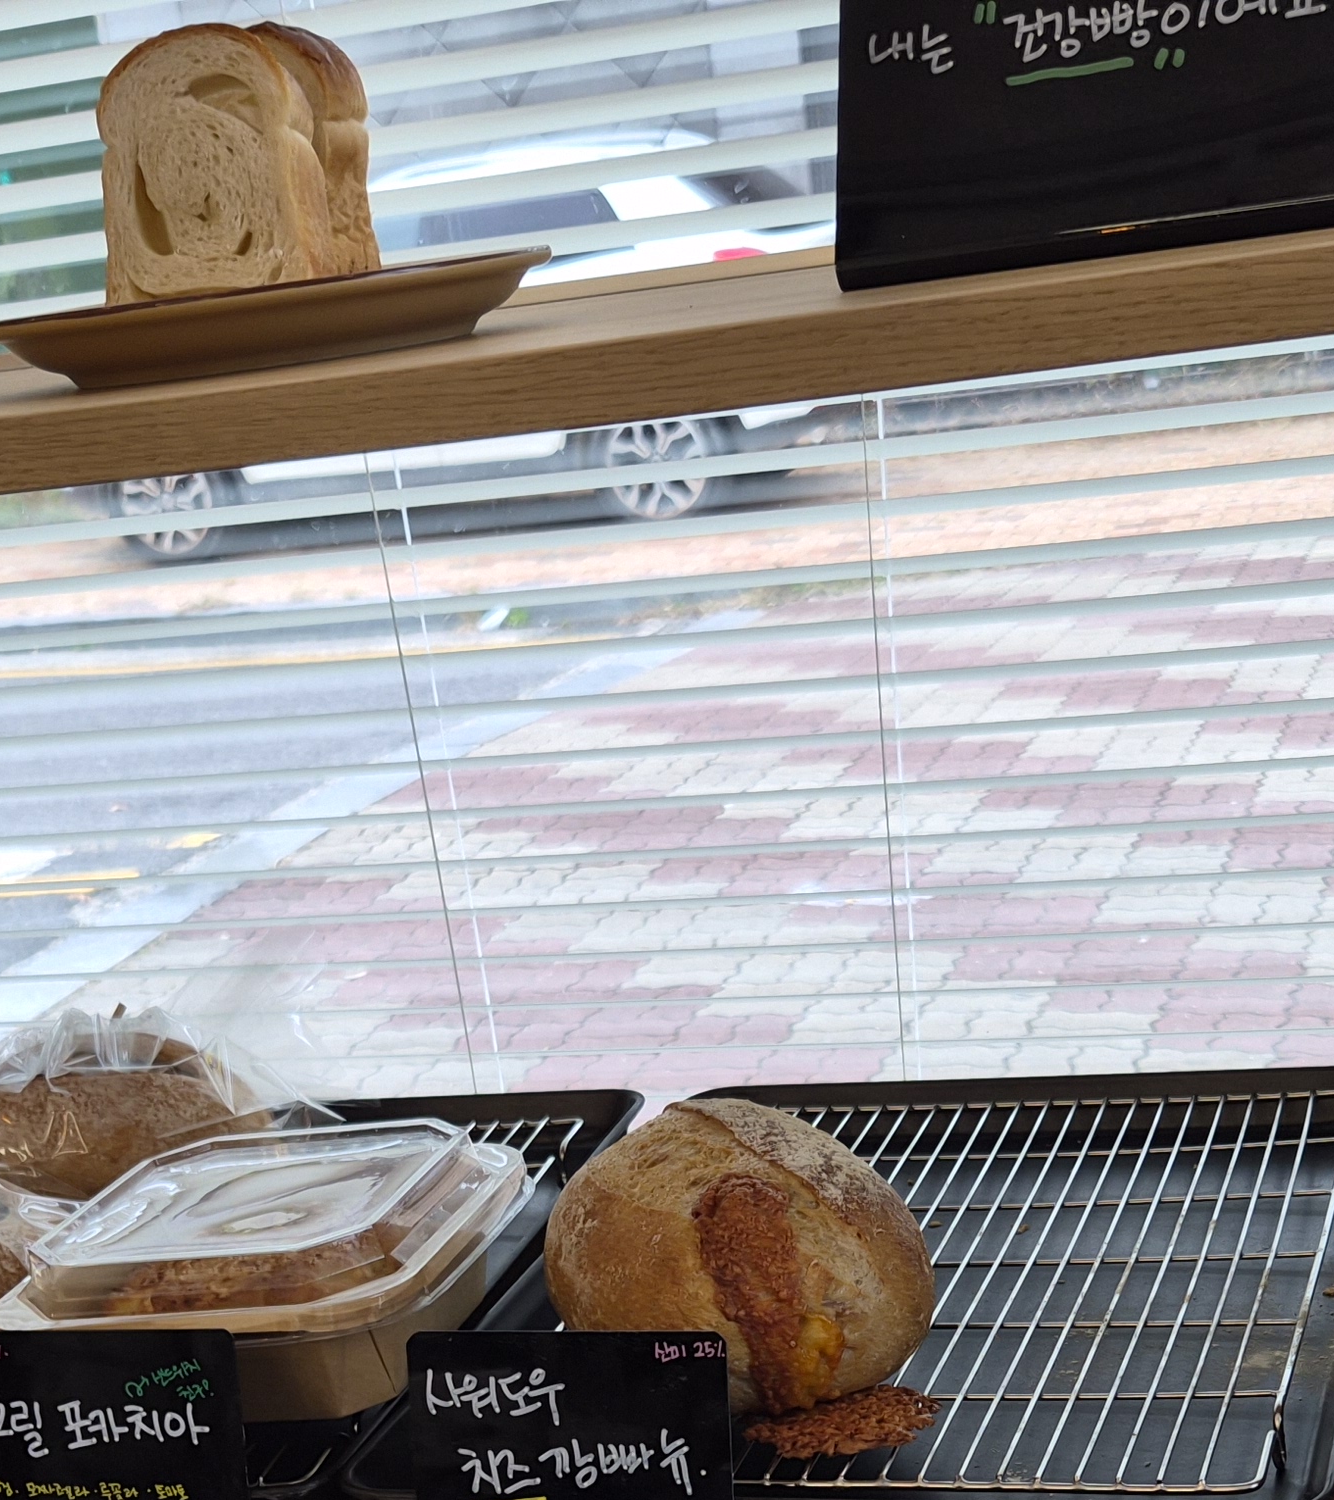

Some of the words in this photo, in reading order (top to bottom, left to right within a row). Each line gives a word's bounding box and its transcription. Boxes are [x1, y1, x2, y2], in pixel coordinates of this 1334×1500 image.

[868, 23, 954, 75] 내는
[426, 1367, 566, 1426] 사워도우
[56, 1399, 211, 1451] 포카치아
[457, 1447, 542, 1495] 치즈
